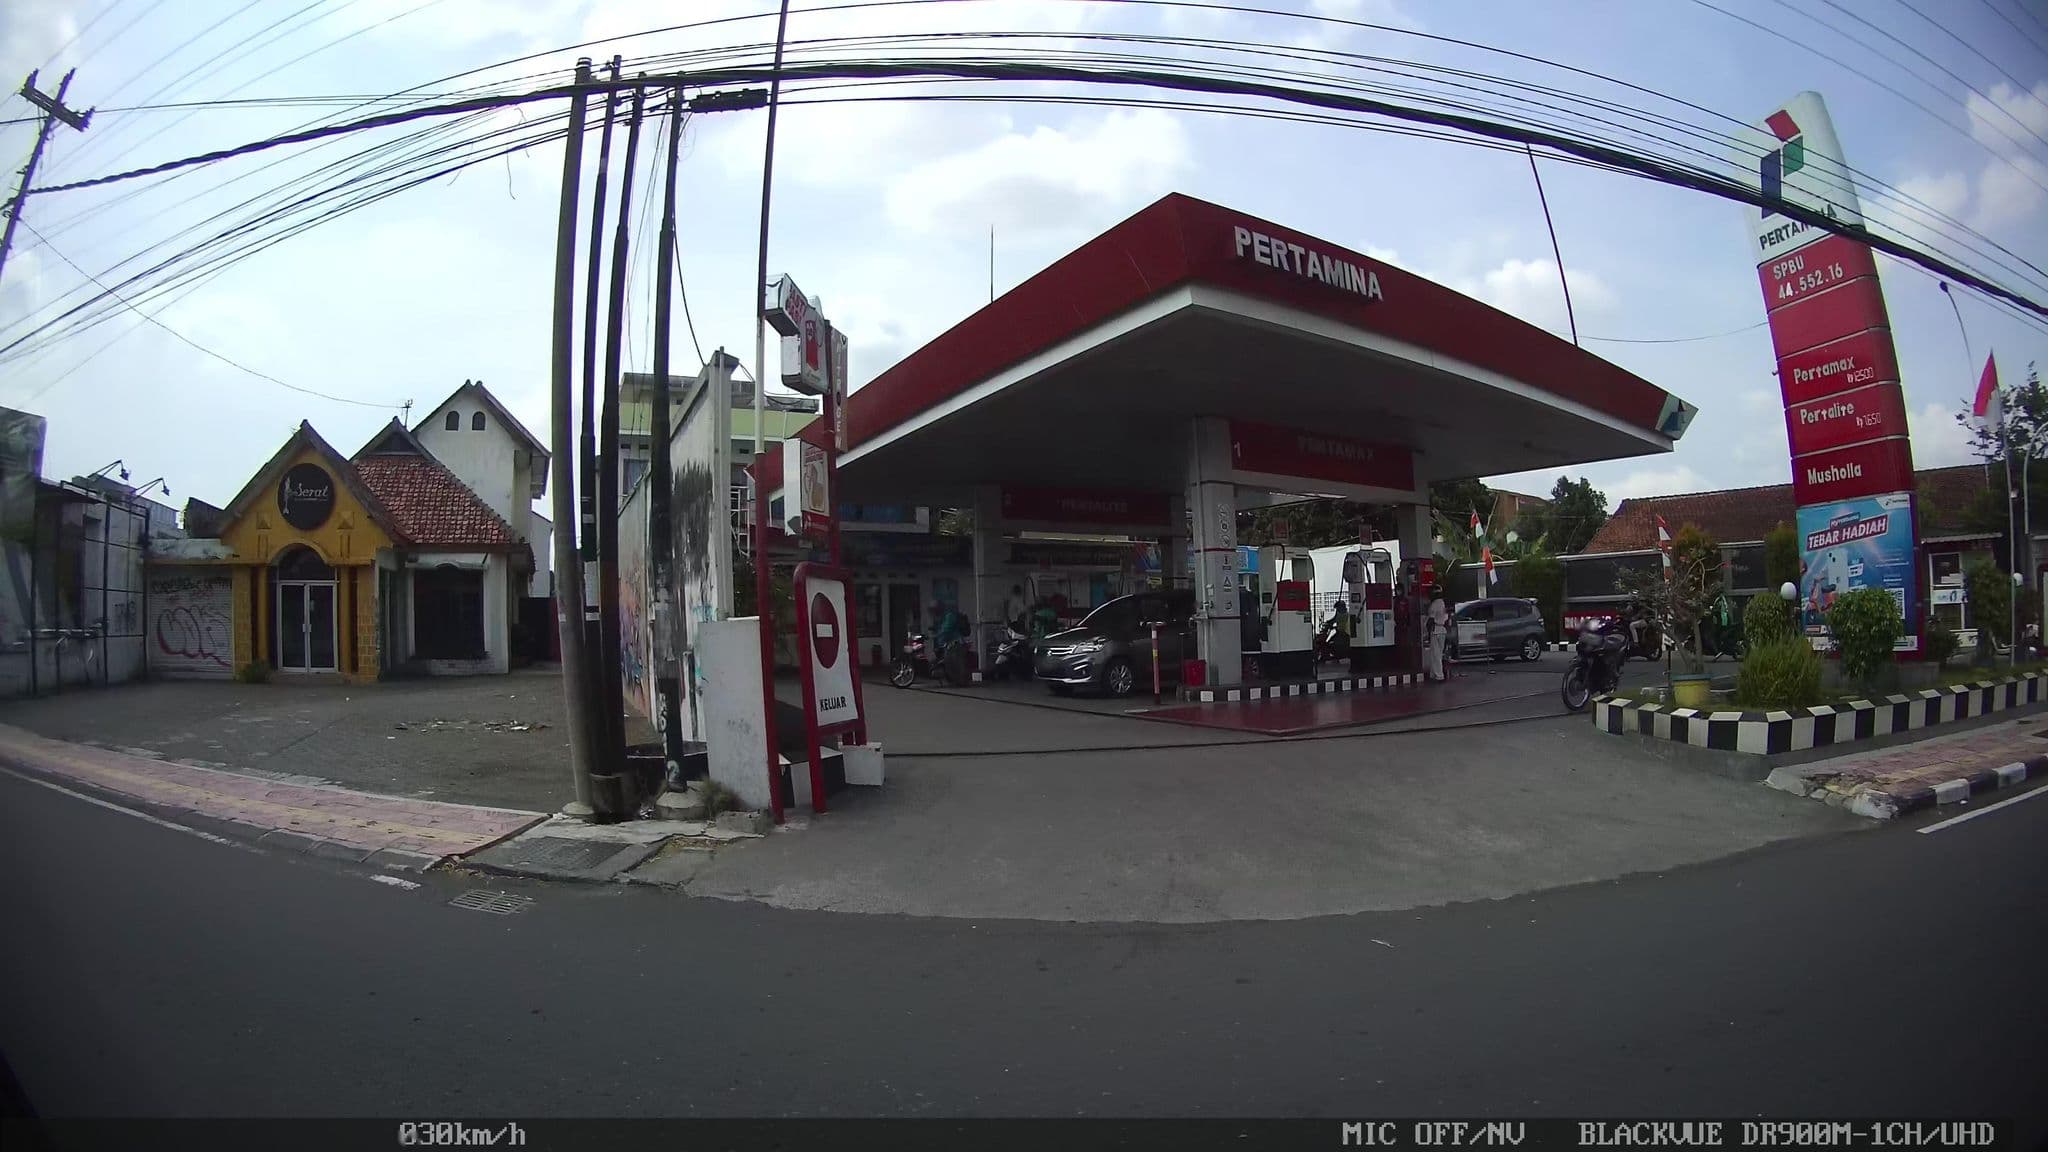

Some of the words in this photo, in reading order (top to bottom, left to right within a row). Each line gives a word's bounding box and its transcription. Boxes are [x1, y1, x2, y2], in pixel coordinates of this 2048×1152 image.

[1759, 204, 1837, 250] PERTAA
[1234, 226, 1383, 300] PERTAMINA
[1773, 255, 1804, 280] SPBU
[1779, 263, 1843, 299] 44.552.16
[1793, 356, 1855, 384] Pertamax
[1800, 403, 1854, 424] Pertalite
[1234, 441, 1241, 458] 1
[1807, 463, 1862, 485] Musholla
[297, 483, 329, 497] Serat
[1808, 531, 1840, 549] TEBAR
[1842, 518, 1886, 540] HADIAH
[820, 696, 847, 712] KELUAR
